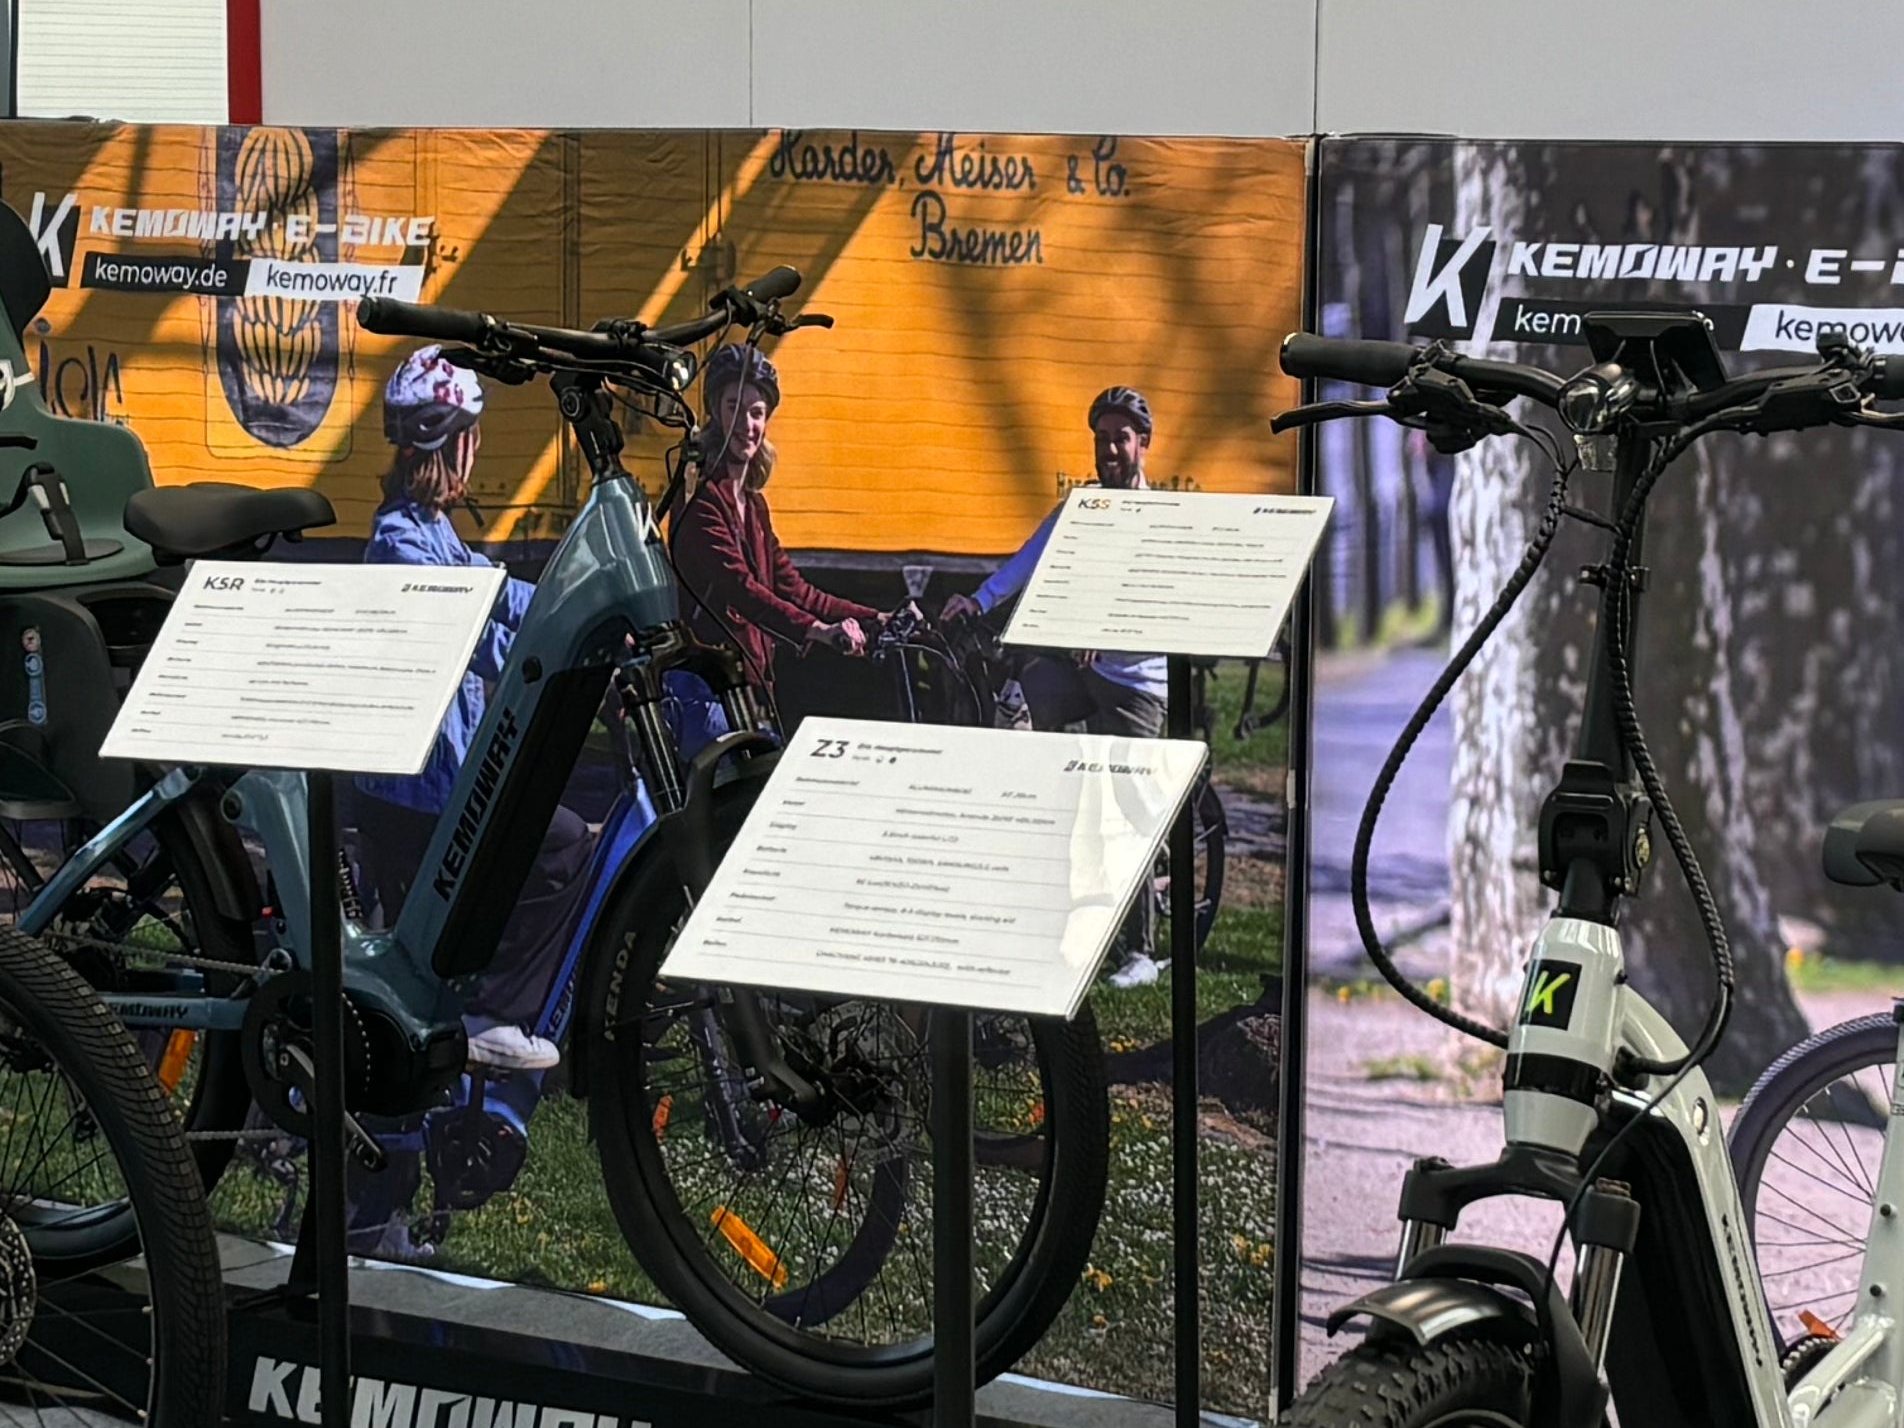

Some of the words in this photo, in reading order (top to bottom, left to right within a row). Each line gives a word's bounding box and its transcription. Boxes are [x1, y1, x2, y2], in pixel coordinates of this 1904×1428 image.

[1067, 154, 1085, 195] &
[1093, 136, 1131, 197] Co.
[89, 205, 267, 241] KEMOWAY
[285, 214, 436, 247] E-BIKE
[910, 190, 1044, 266] Bremen
[95, 257, 227, 290] kemoway.de
[266, 263, 397, 298] kemoway.fr
[1403, 223, 1493, 327] K
[1508, 240, 1778, 285] KEMOWAY
[810, 738, 849, 759] Z3
[432, 705, 520, 903] KEMOWAY
[603, 931, 637, 1042] KENDA
[1527, 972, 1564, 1015] K
